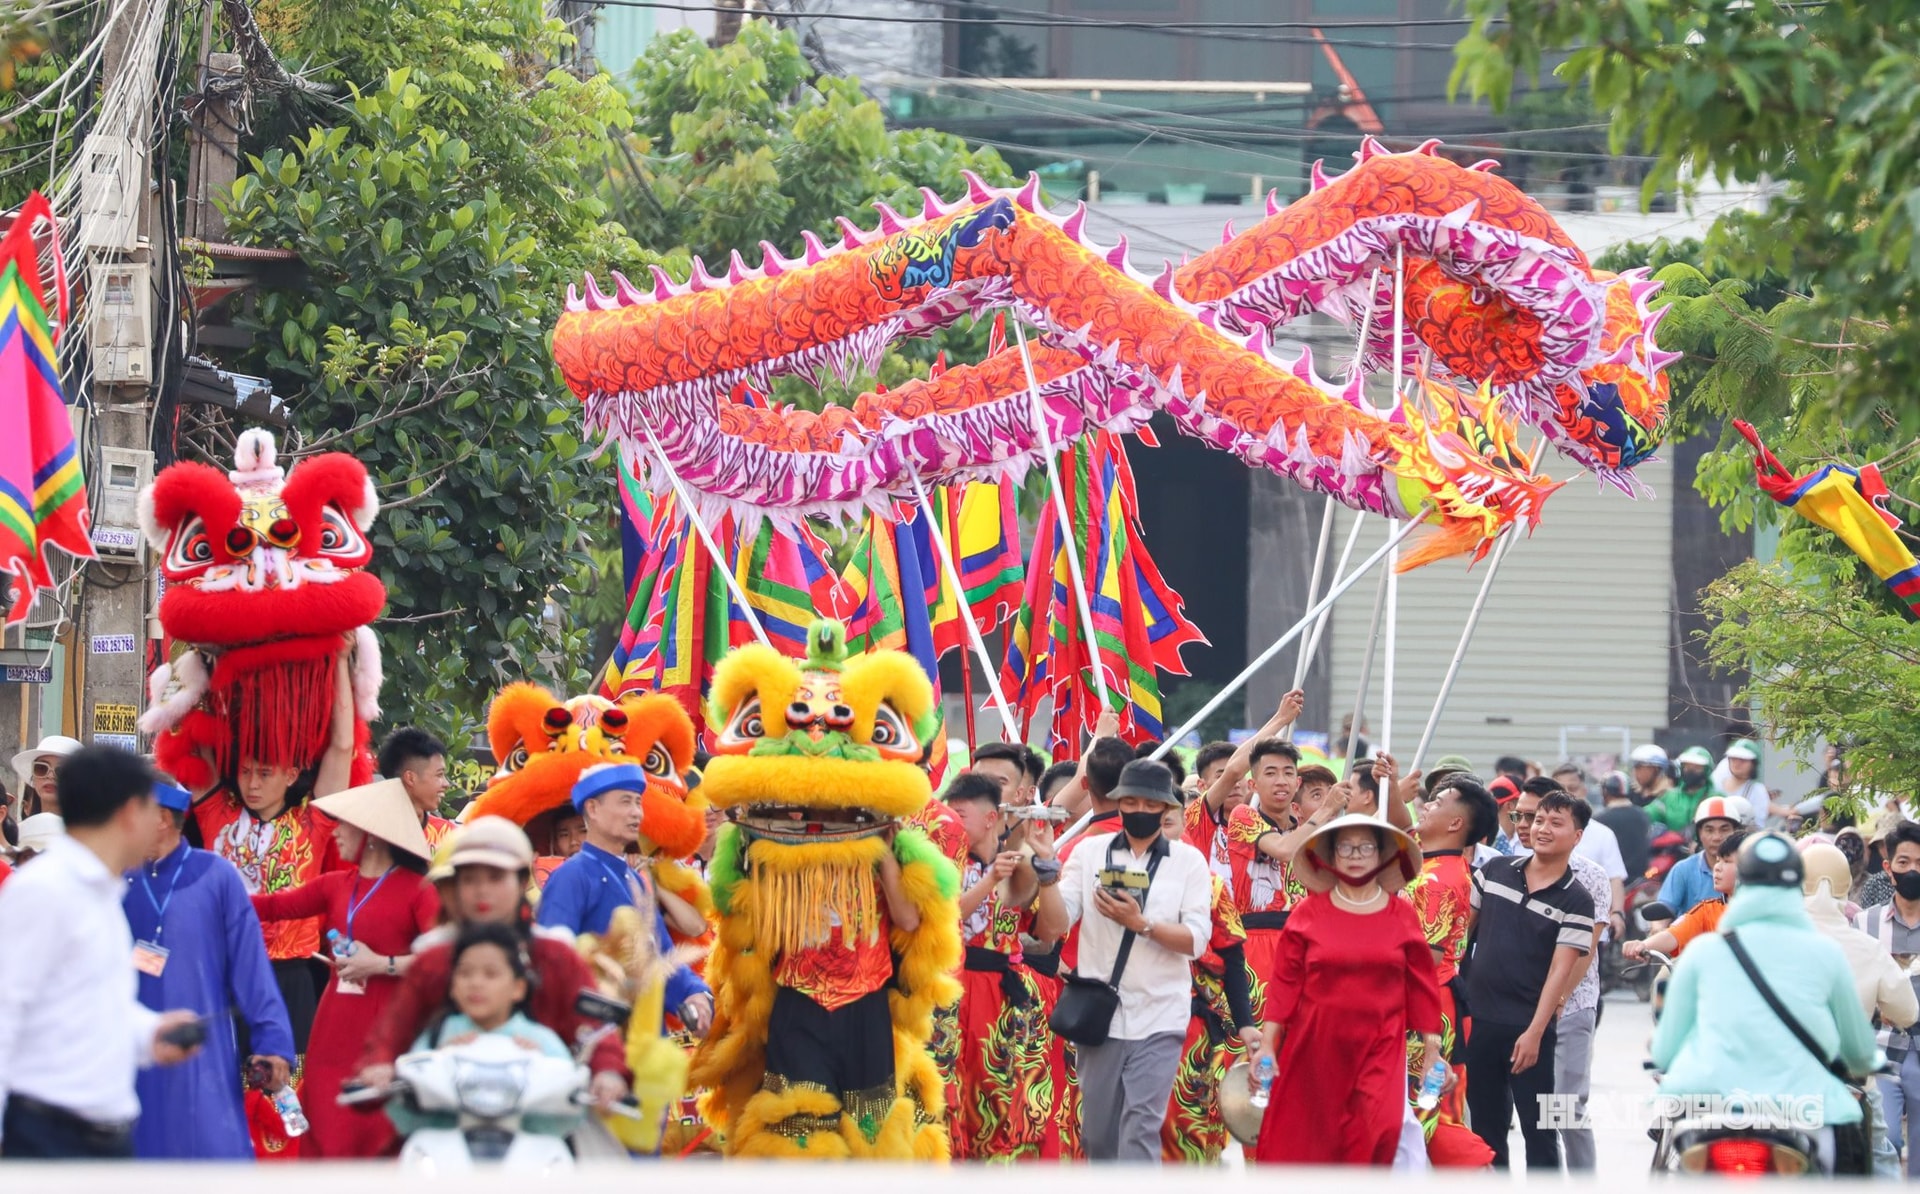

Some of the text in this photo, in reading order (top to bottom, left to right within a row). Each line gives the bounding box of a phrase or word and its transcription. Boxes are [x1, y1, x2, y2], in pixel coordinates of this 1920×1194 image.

[109, 534, 121, 544] 252
[122, 535, 134, 545] 768
[94, 639, 134, 652] 0982 252 768
[24, 669, 36, 681] 252
